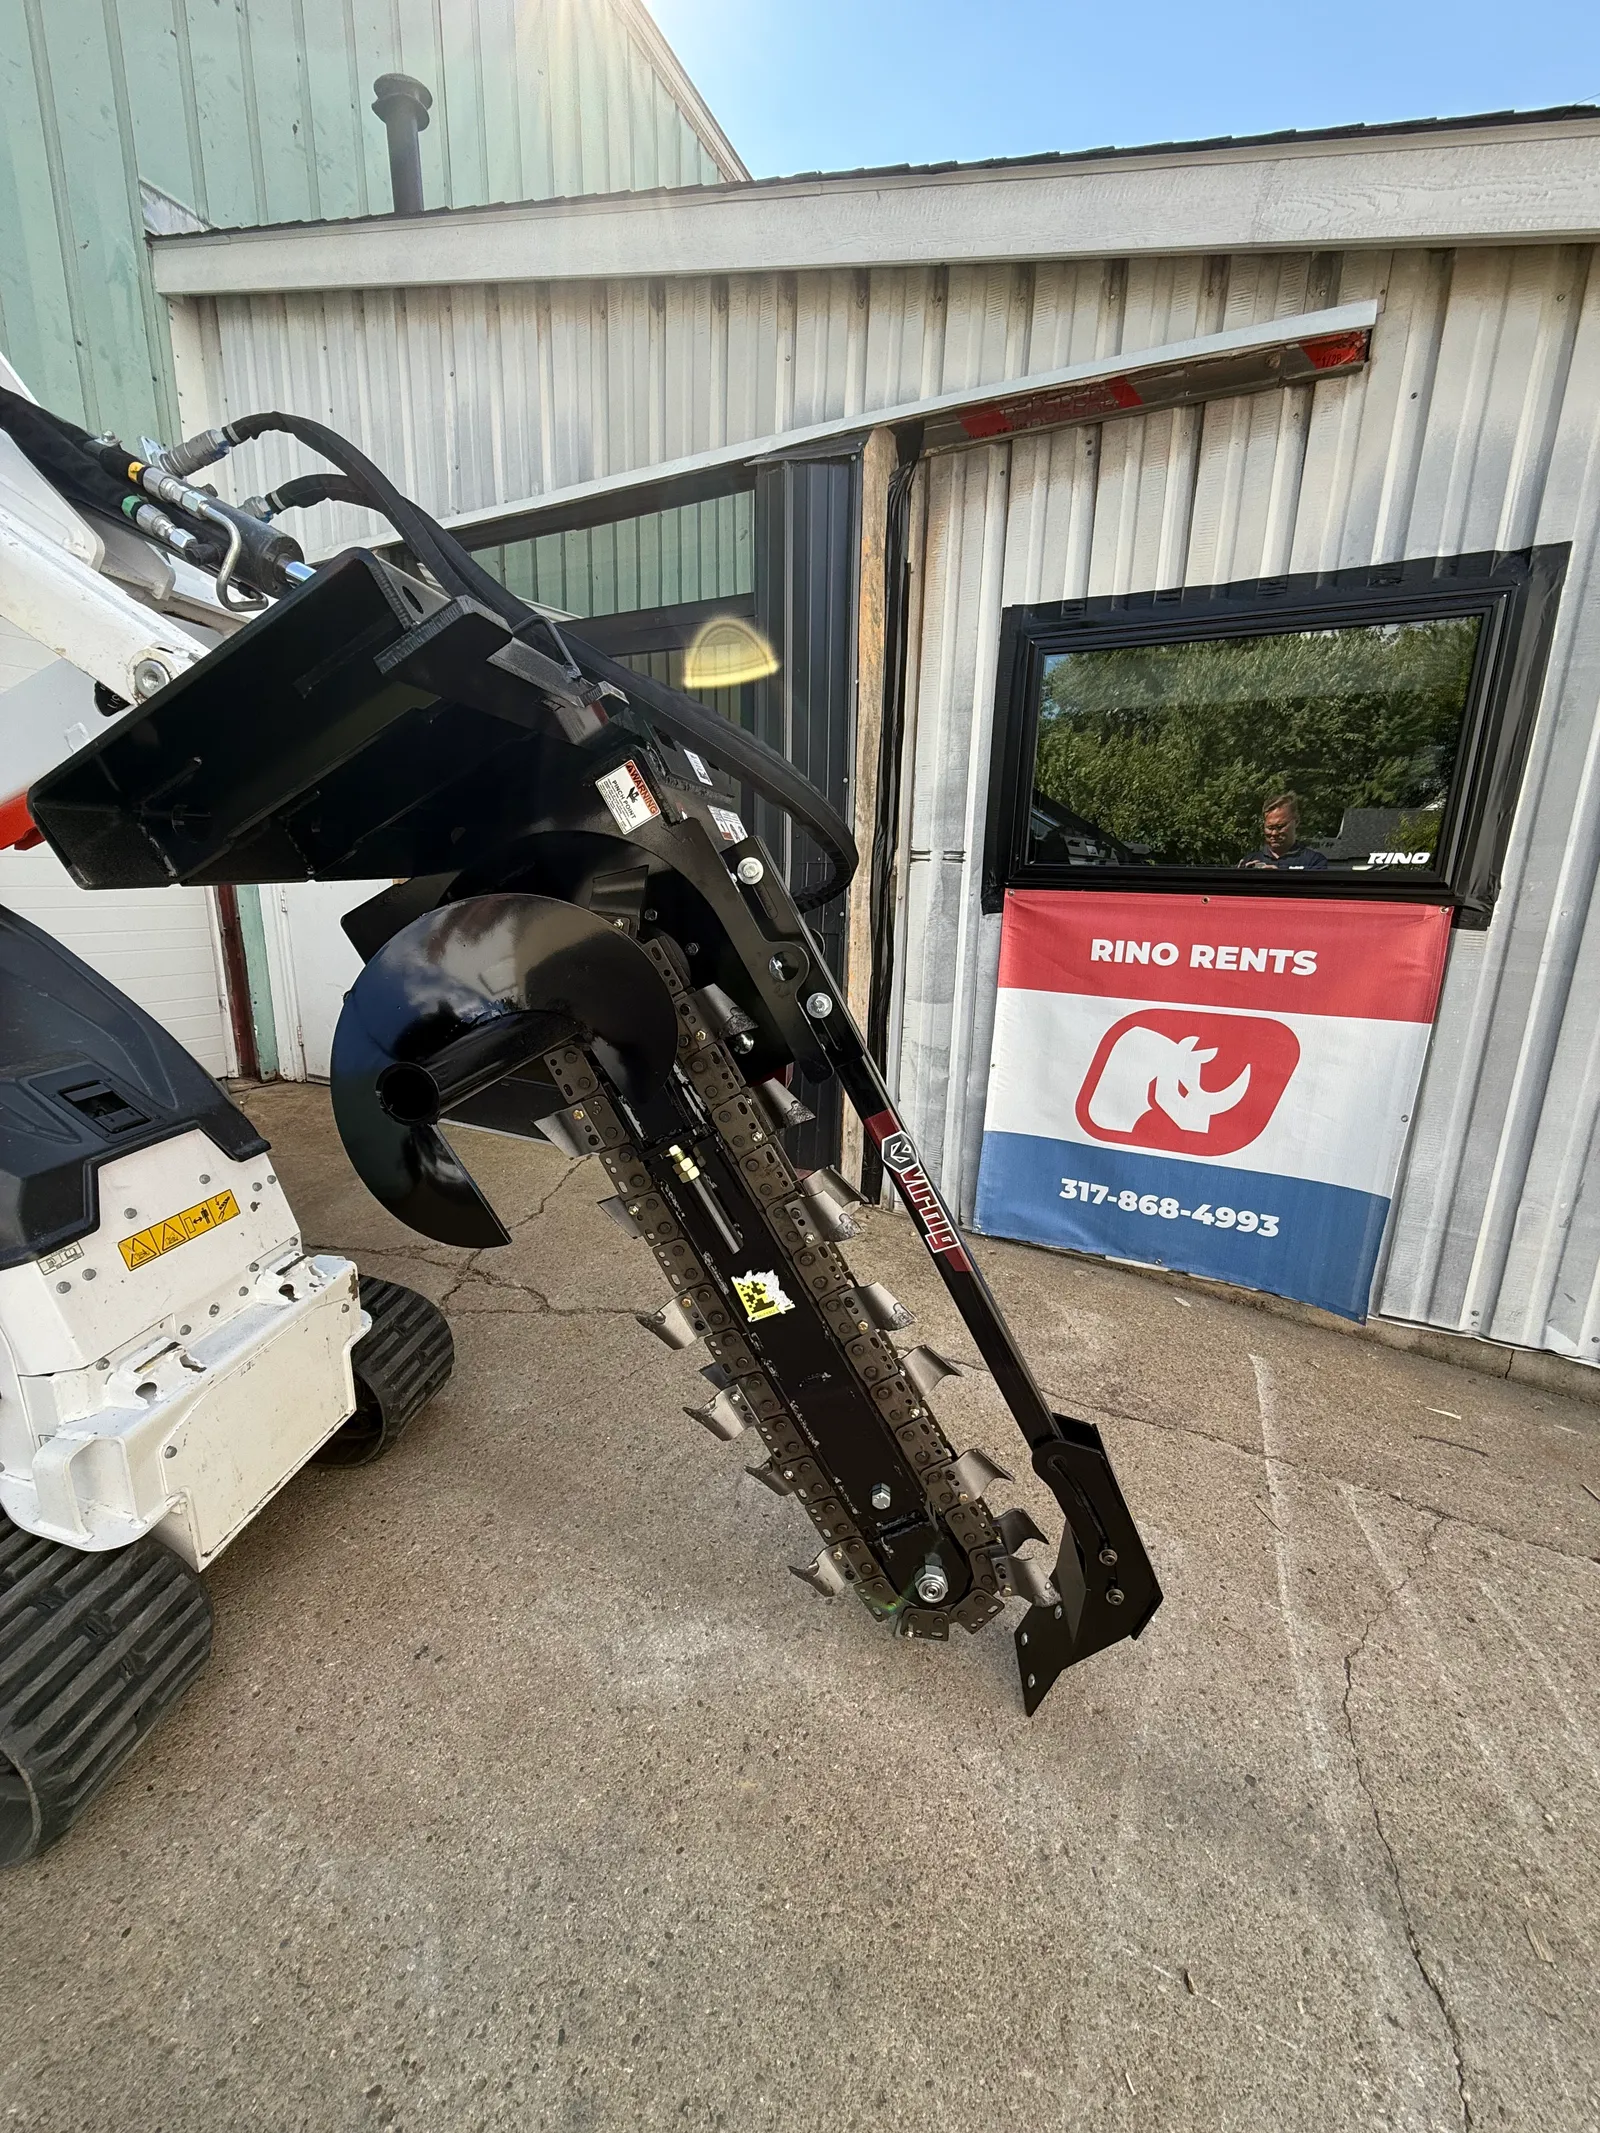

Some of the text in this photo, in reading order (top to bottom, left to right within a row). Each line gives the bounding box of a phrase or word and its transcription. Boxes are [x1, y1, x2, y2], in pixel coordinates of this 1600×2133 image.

[611, 780, 637, 819] PINCH POINT
[630, 768, 658, 814] WARNING
[1367, 852, 1431, 864] RINO
[1090, 938, 1318, 976] RINO RENTS
[1059, 1178, 1280, 1237] 317-868-4993
